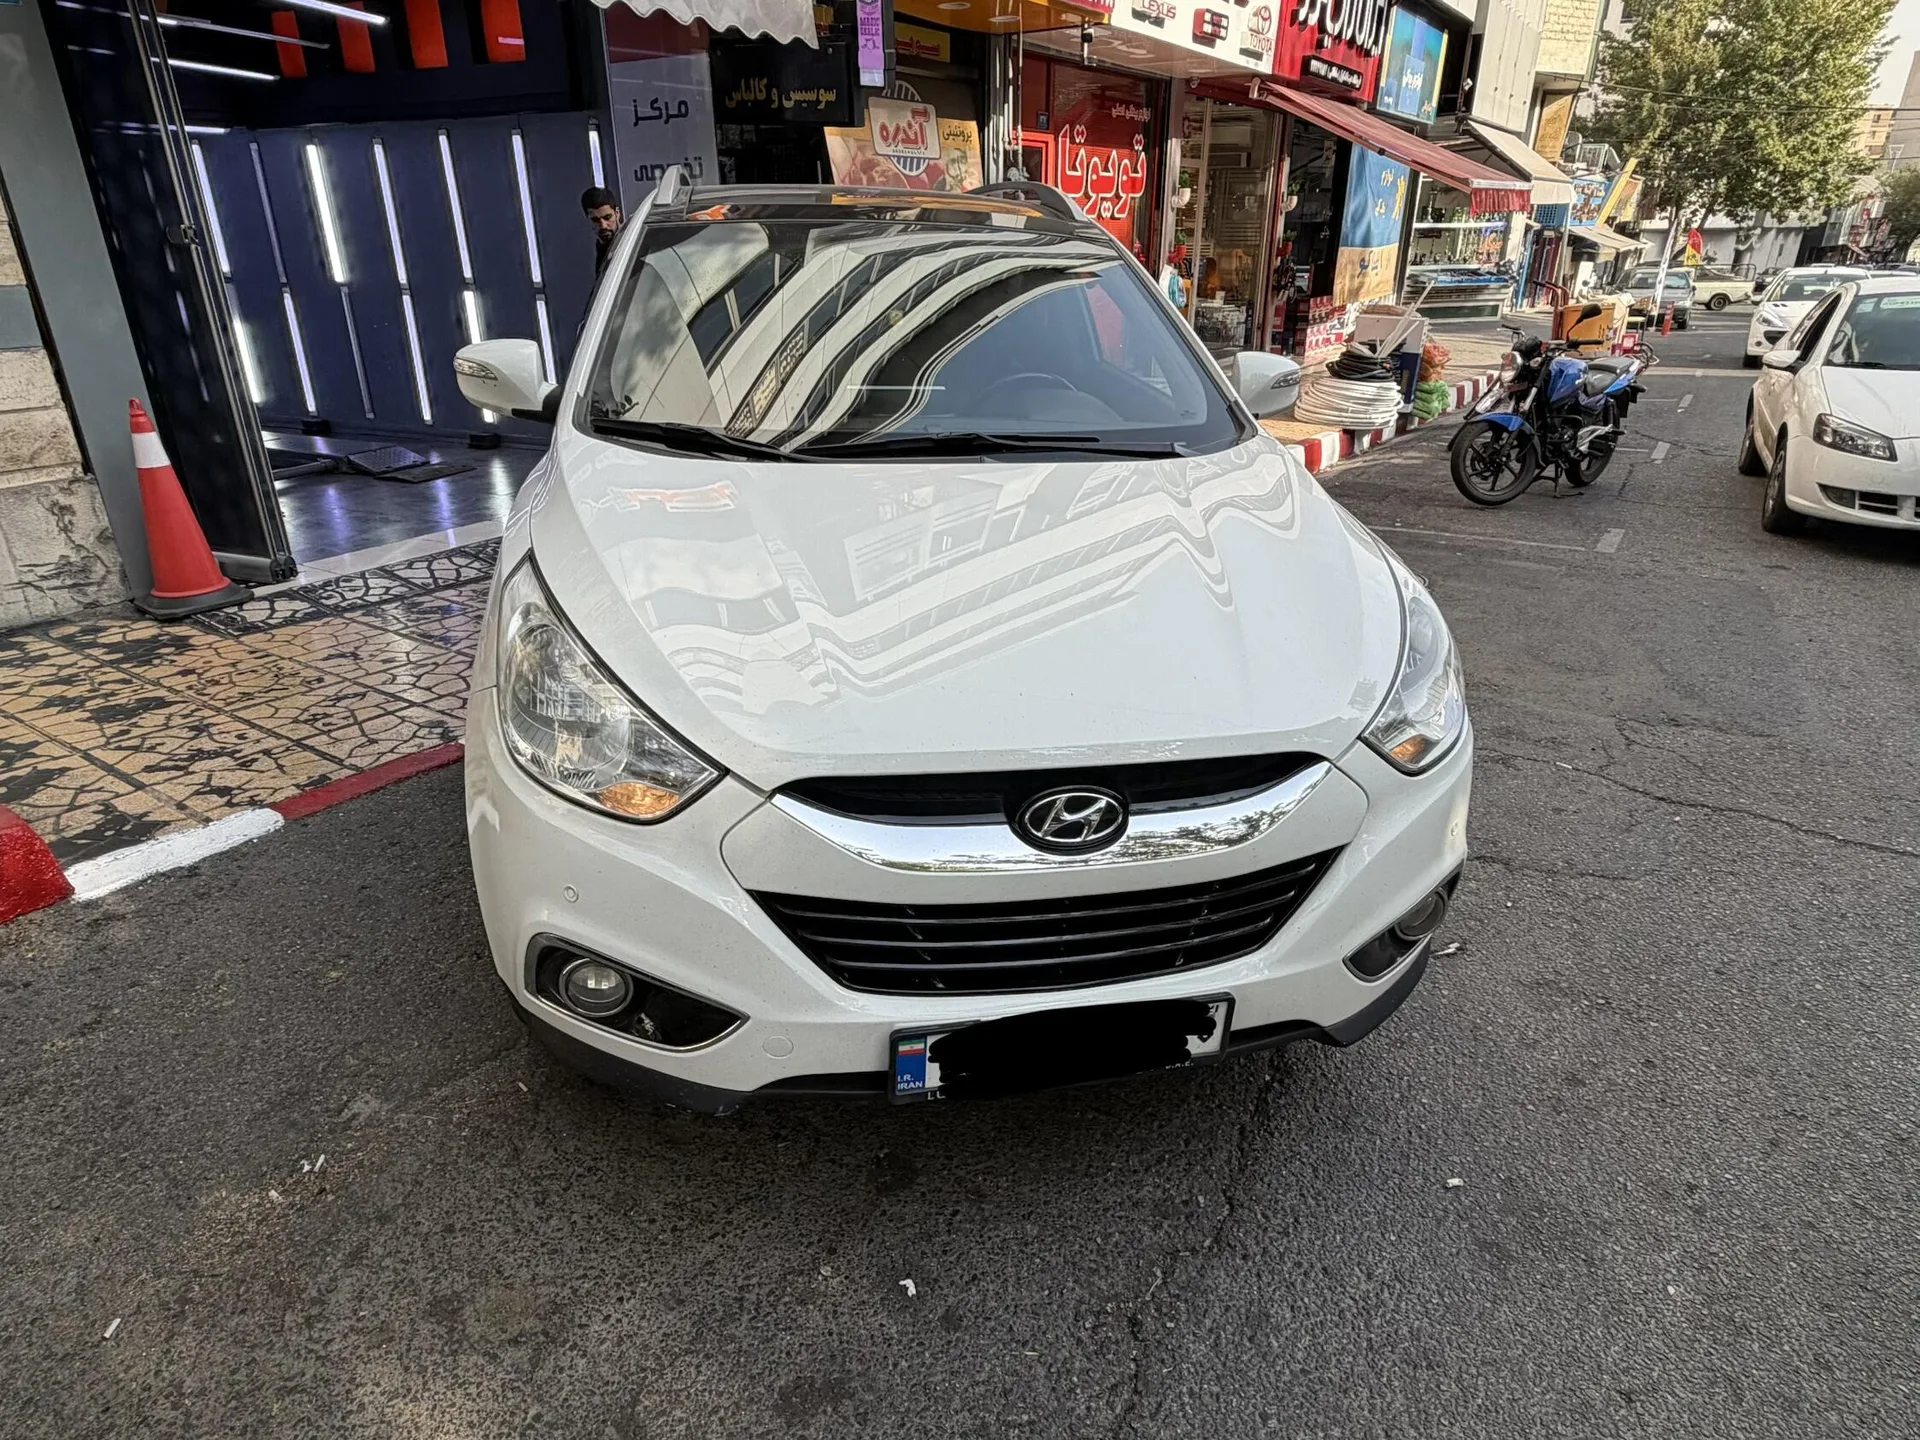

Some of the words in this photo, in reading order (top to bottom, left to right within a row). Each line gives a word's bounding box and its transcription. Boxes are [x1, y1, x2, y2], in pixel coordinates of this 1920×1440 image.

[1250, 33, 1272, 52] TOYOTA
[725, 77, 767, 108] کالباس
[771, 87, 778, 108] و
[782, 88, 836, 109] سوسیس
[633, 97, 689, 127] مرکز
[879, 106, 930, 150] آندره
[1058, 124, 1147, 217] تویوتا
[897, 1074, 914, 1082] I.R.
[897, 1081, 923, 1090] IRAN
